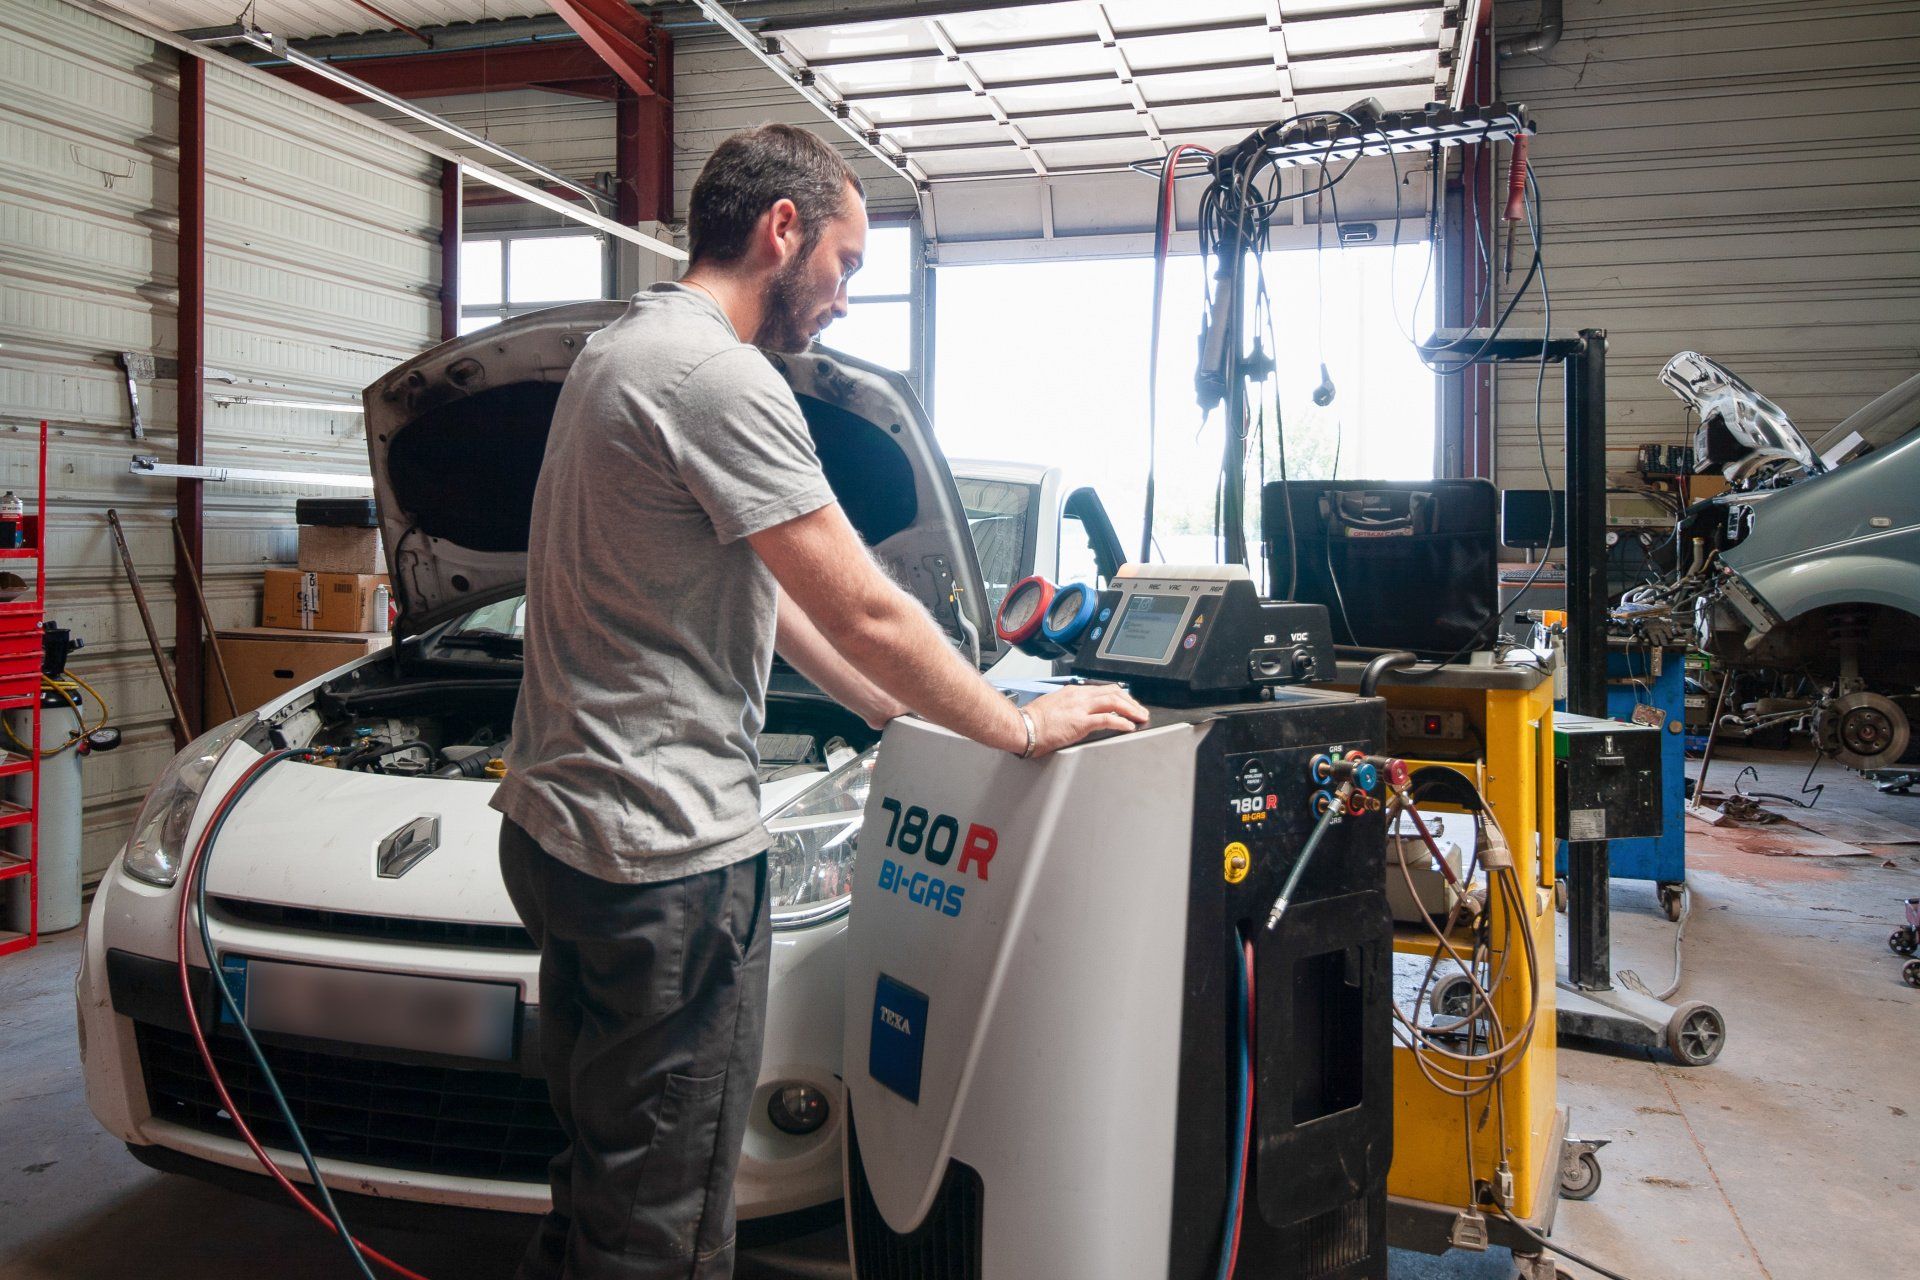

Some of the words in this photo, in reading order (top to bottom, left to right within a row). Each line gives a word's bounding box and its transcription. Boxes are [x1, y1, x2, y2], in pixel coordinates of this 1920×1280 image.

[1264, 634, 1276, 643] SD
[1291, 632, 1308, 641] VDC
[1241, 811, 1267, 822] BI-GAS
[878, 859, 965, 918] BI-GAS
[879, 1005, 911, 1036] TEXA
